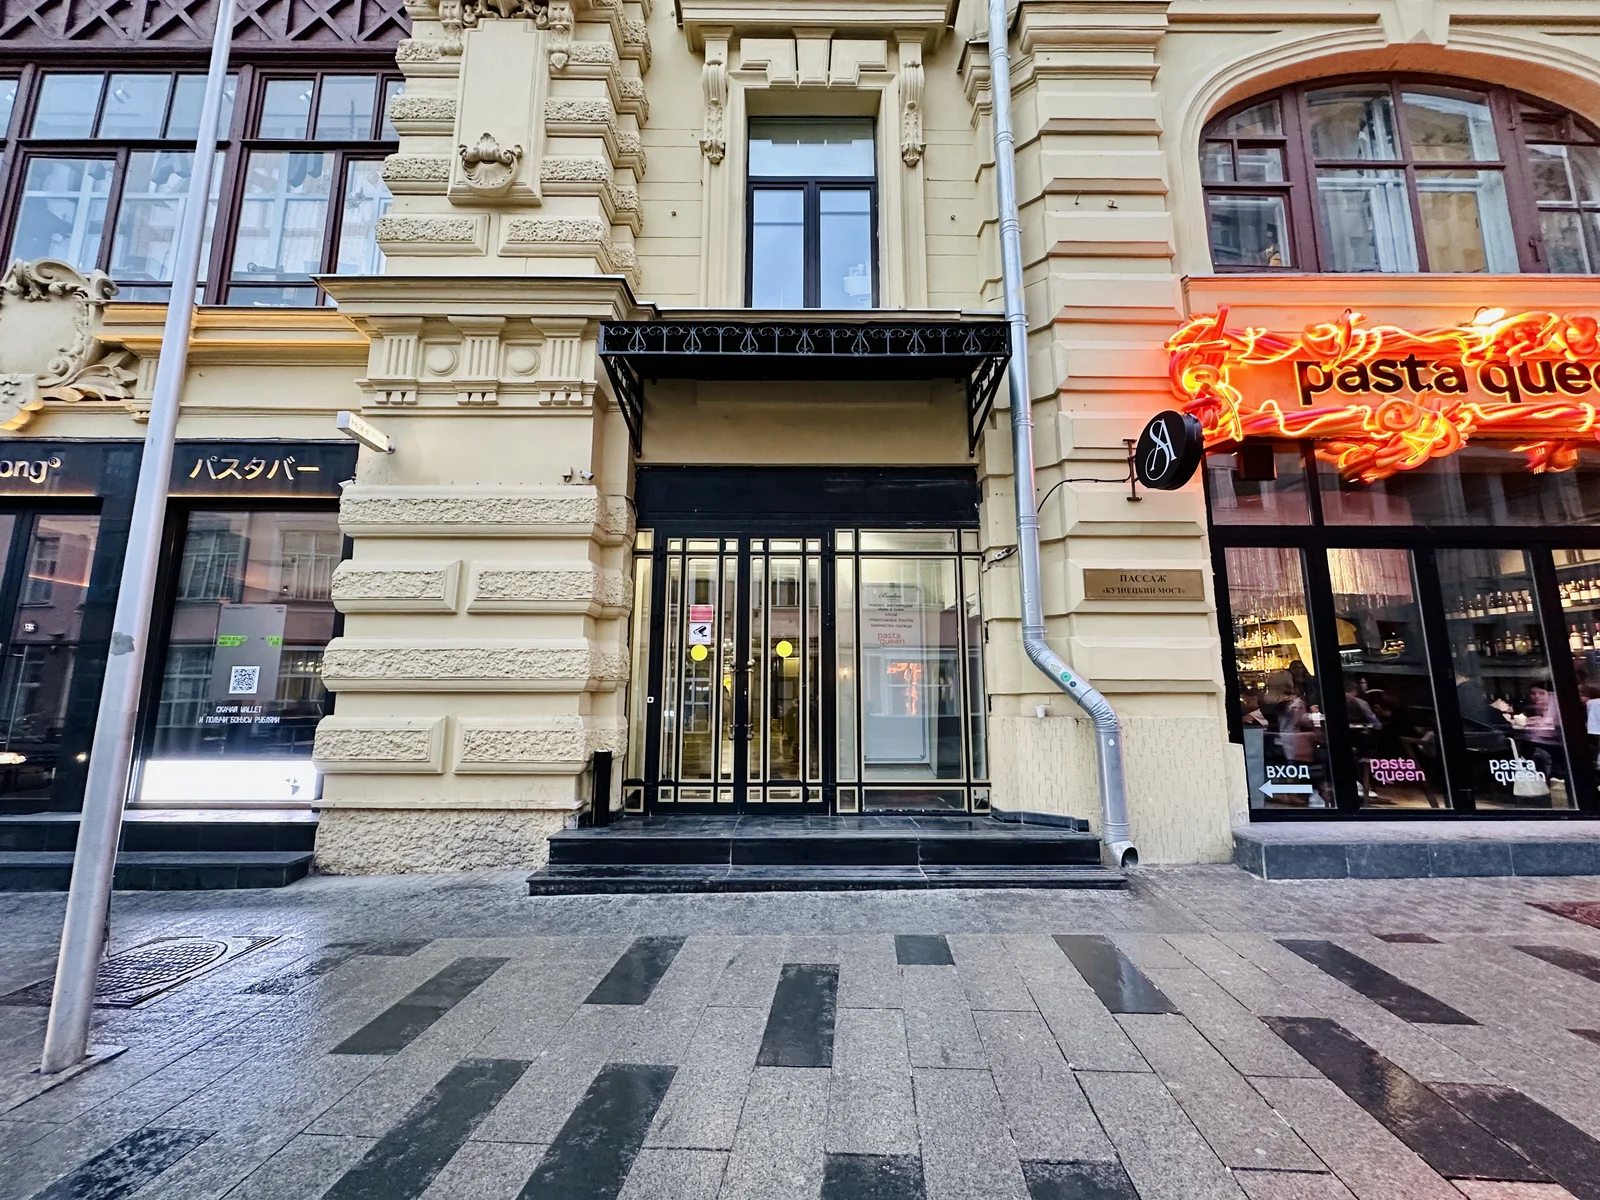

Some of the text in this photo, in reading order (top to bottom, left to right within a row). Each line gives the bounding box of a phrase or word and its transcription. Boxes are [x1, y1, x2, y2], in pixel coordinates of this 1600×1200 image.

[1295, 354, 1600, 405] pasta que
[189, 455, 320, 480] パスタバー
[1120, 574, 1167, 583] ПАССАЖ
[877, 632, 901, 641] pasta
[879, 638, 906, 647] queen
[216, 705, 263, 714] СКАЧАЙ WALLET
[205, 716, 229, 724] ПОЛУЧИ
[230, 716, 253, 724] БОНУСЫ
[254, 716, 280, 724] РУБЛЯМИ
[1266, 764, 1310, 779] ВХОД
[1370, 757, 1416, 774] pasta
[1489, 758, 1536, 773] pasta
[1374, 769, 1426, 785] queen
[1494, 769, 1546, 786] queen
